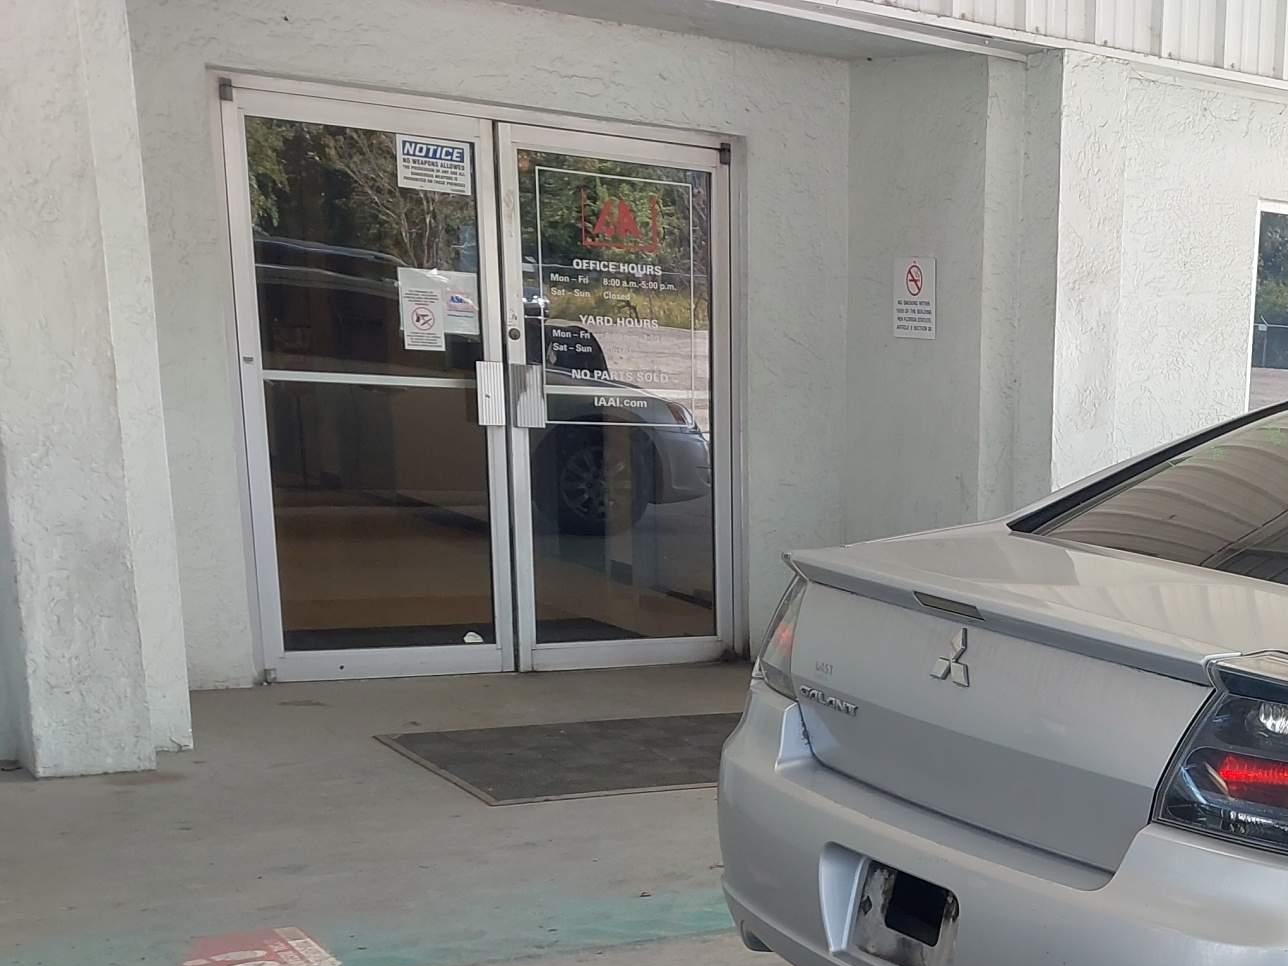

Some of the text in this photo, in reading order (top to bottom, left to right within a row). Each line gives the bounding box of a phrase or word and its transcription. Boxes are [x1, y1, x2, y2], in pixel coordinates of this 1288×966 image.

[403, 142, 463, 160] NOTICE
[572, 258, 662, 276] OFFICE HOURS
[550, 273, 570, 282] Mon
[578, 274, 589, 284] Fri
[603, 278, 620, 287] 8:00
[551, 287, 565, 296] Sat
[574, 288, 591, 298] Sun
[603, 291, 631, 300] Closed
[579, 314, 659, 328] YARD HOURS
[552, 329, 571, 338] Mon
[553, 343, 567, 352] Sat
[575, 343, 592, 353] Sun
[571, 369, 669, 383] NO PARTS SOLD
[594, 396, 648, 408] IAAI.com
[799, 683, 859, 717] GALANT
